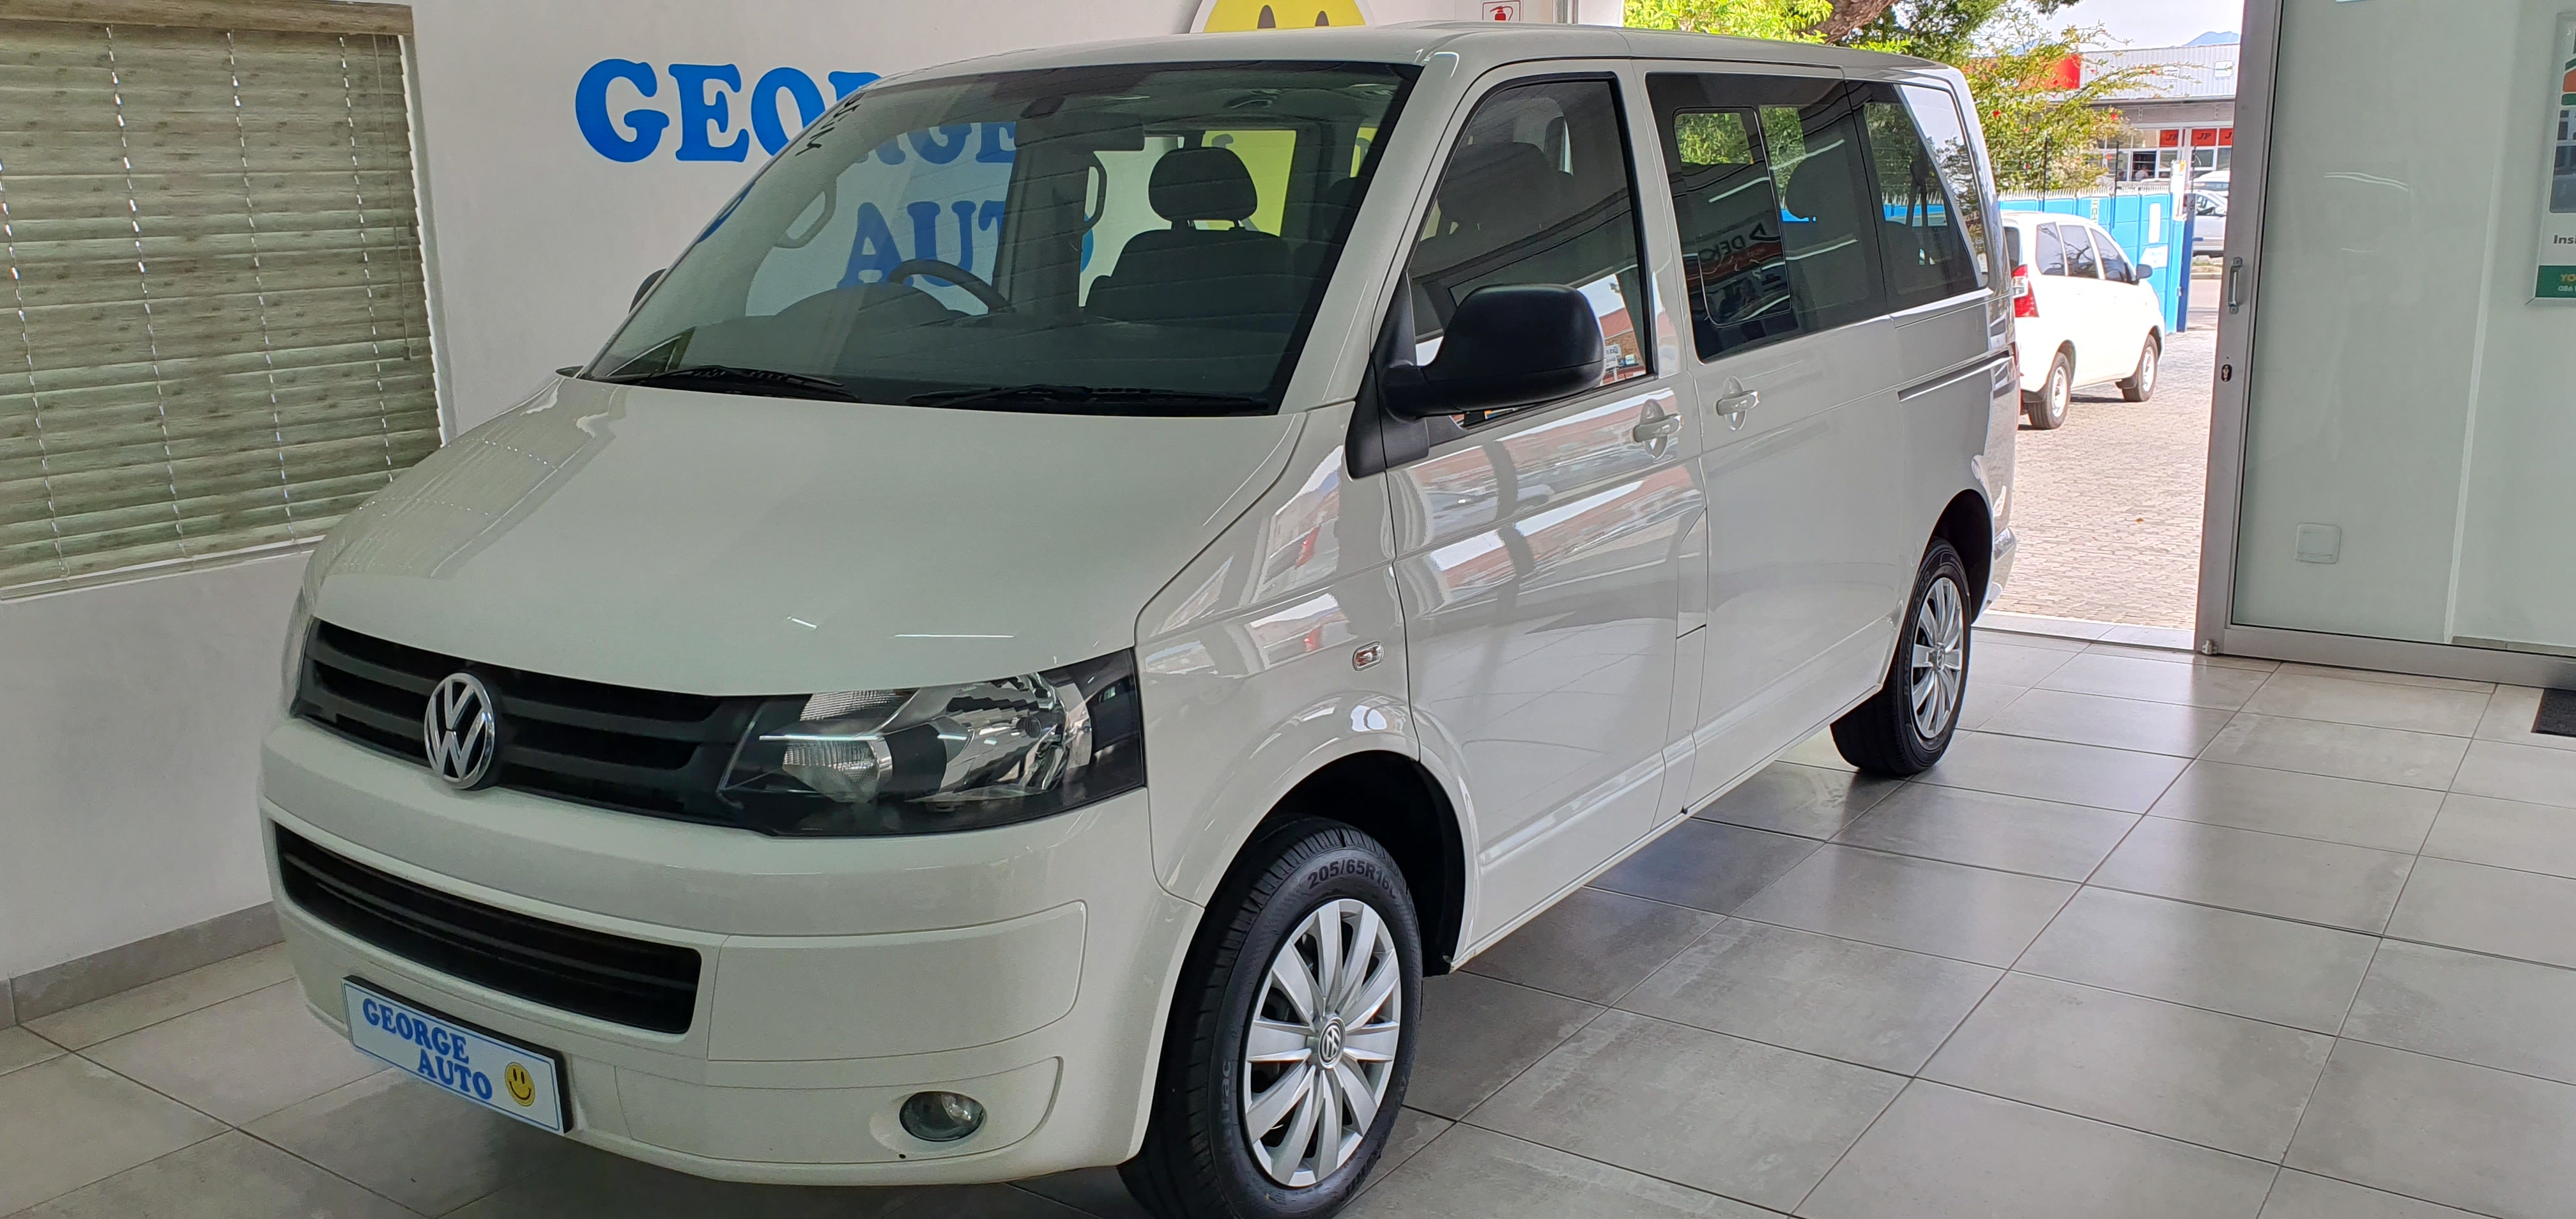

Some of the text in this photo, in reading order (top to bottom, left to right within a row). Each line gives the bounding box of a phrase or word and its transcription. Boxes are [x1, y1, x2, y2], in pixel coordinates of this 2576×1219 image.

[424, 672, 494, 790] VW
[362, 998, 469, 1064] GEORGE
[418, 1049, 493, 1100] AUTO
